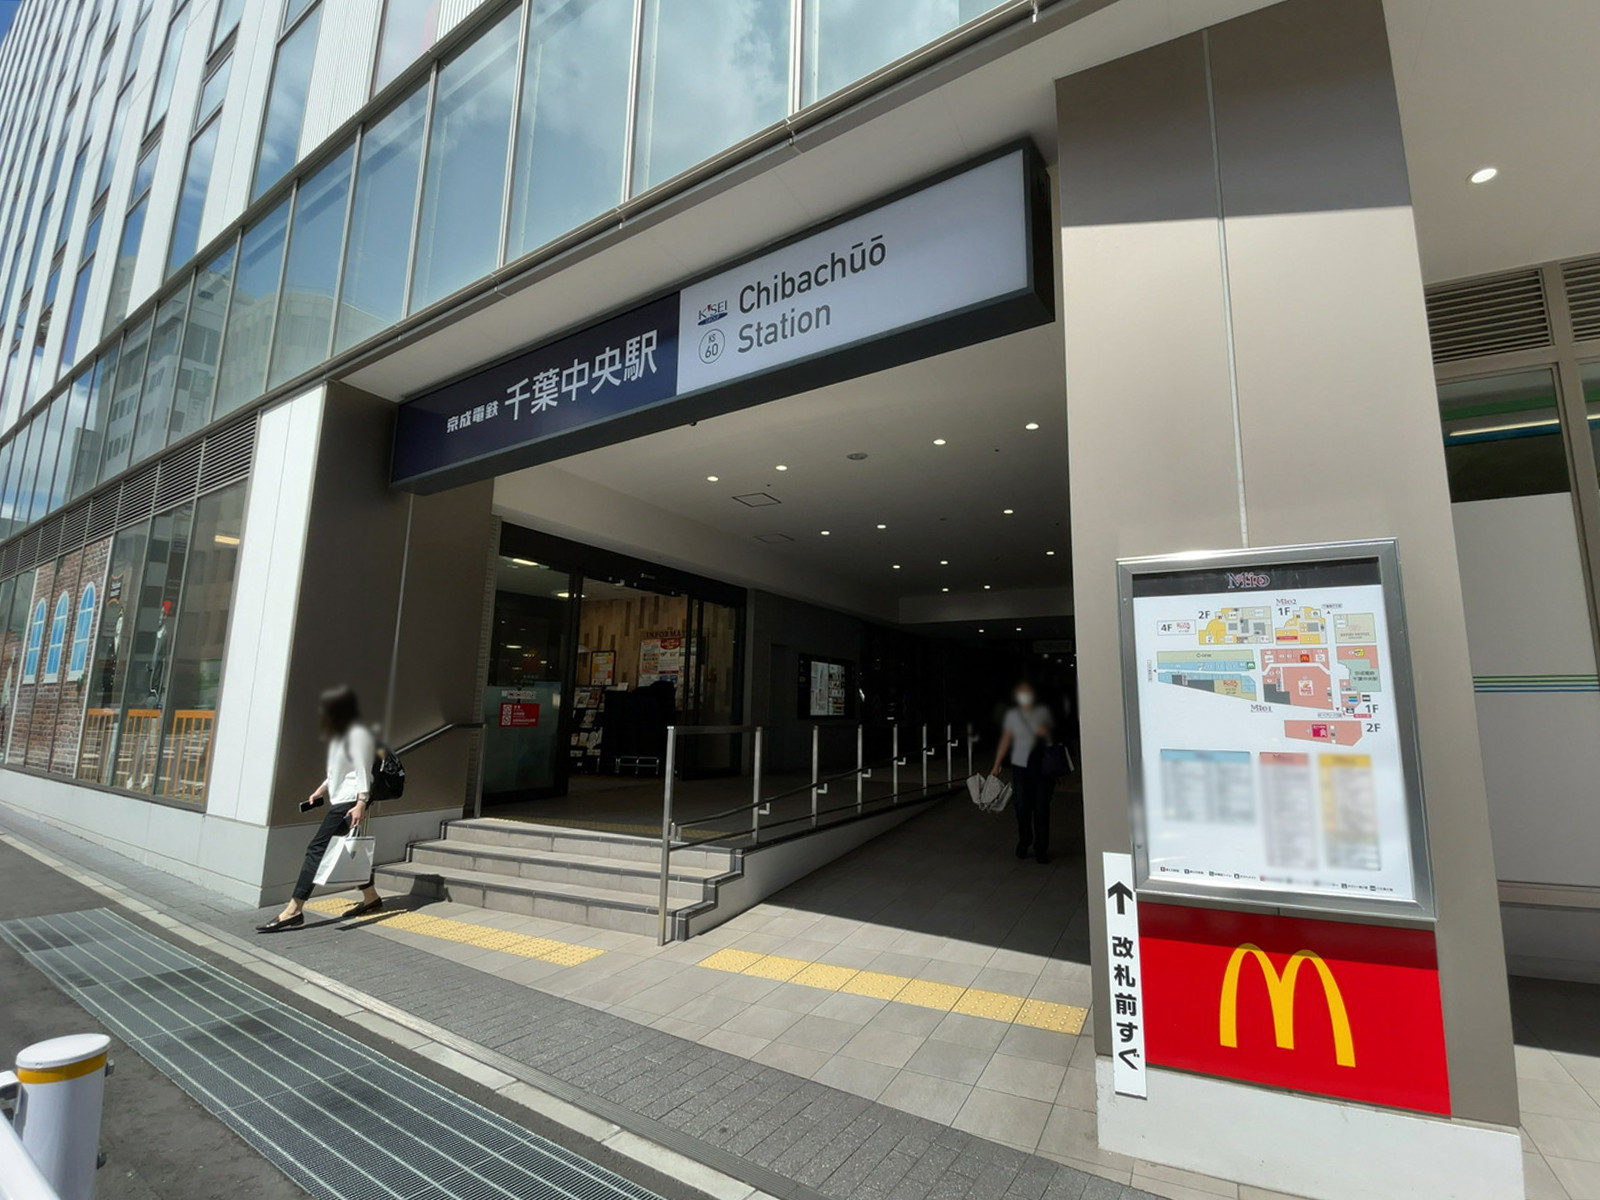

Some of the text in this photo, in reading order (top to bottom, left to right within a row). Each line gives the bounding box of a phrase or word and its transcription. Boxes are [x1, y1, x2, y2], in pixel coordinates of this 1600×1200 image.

[738, 234, 887, 315] Chibachūō
[736, 303, 832, 354] Station
[704, 343, 719, 359] 60
[446, 329, 658, 434] 京成電鉄 千葉中央駅
[1198, 610, 1211, 620] 2F
[1277, 606, 1291, 616] 1F
[1160, 623, 1173, 632] 4F
[1365, 704, 1379, 714] 1F
[1366, 723, 1381, 733] 2F
[1111, 936, 1140, 1071] 改札前すぐ
